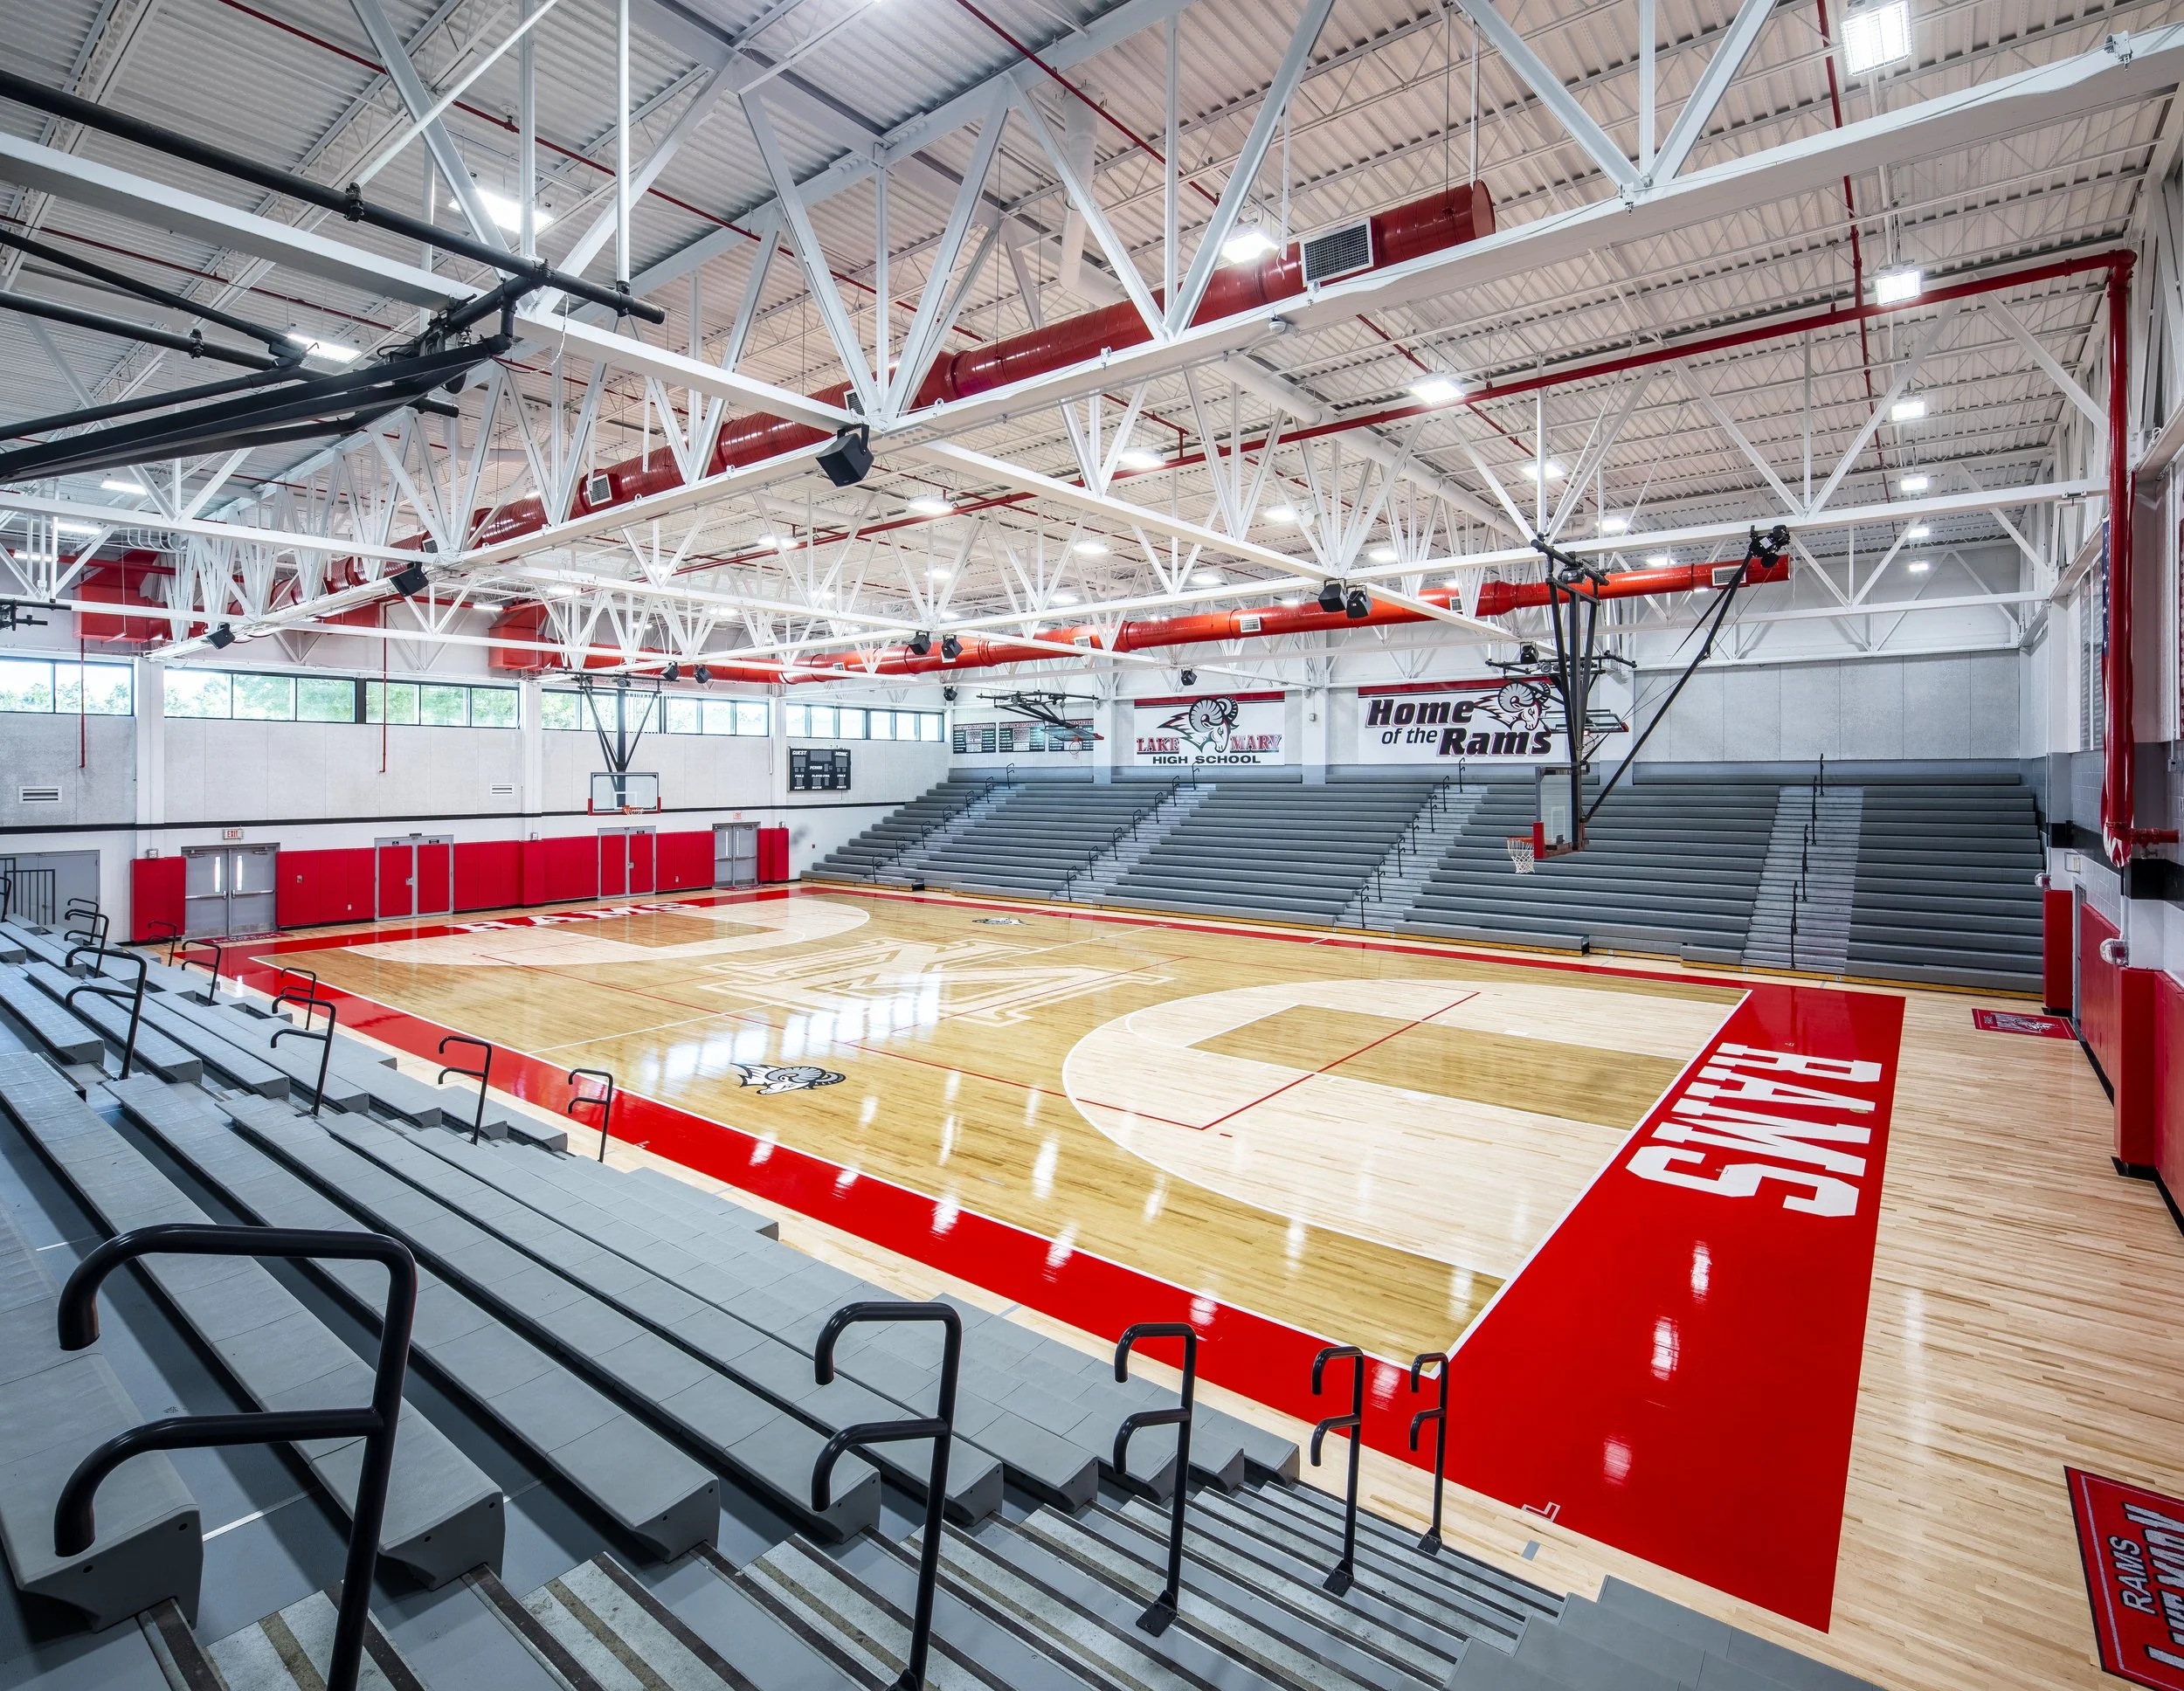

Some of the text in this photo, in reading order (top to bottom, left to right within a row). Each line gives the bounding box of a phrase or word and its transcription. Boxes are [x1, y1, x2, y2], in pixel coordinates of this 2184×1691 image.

[1366, 698, 1475, 727] Home
[1137, 734, 1282, 753] LAKE MARY
[1381, 728, 1439, 744] of the
[1438, 727, 1552, 756] Rams
[1152, 755, 1261, 764] HIGH SCHOOL
[444, 901, 702, 933] RAMS
[1625, 1042, 1883, 1218] RAMS
[2108, 1535, 2157, 1616] RAMS
